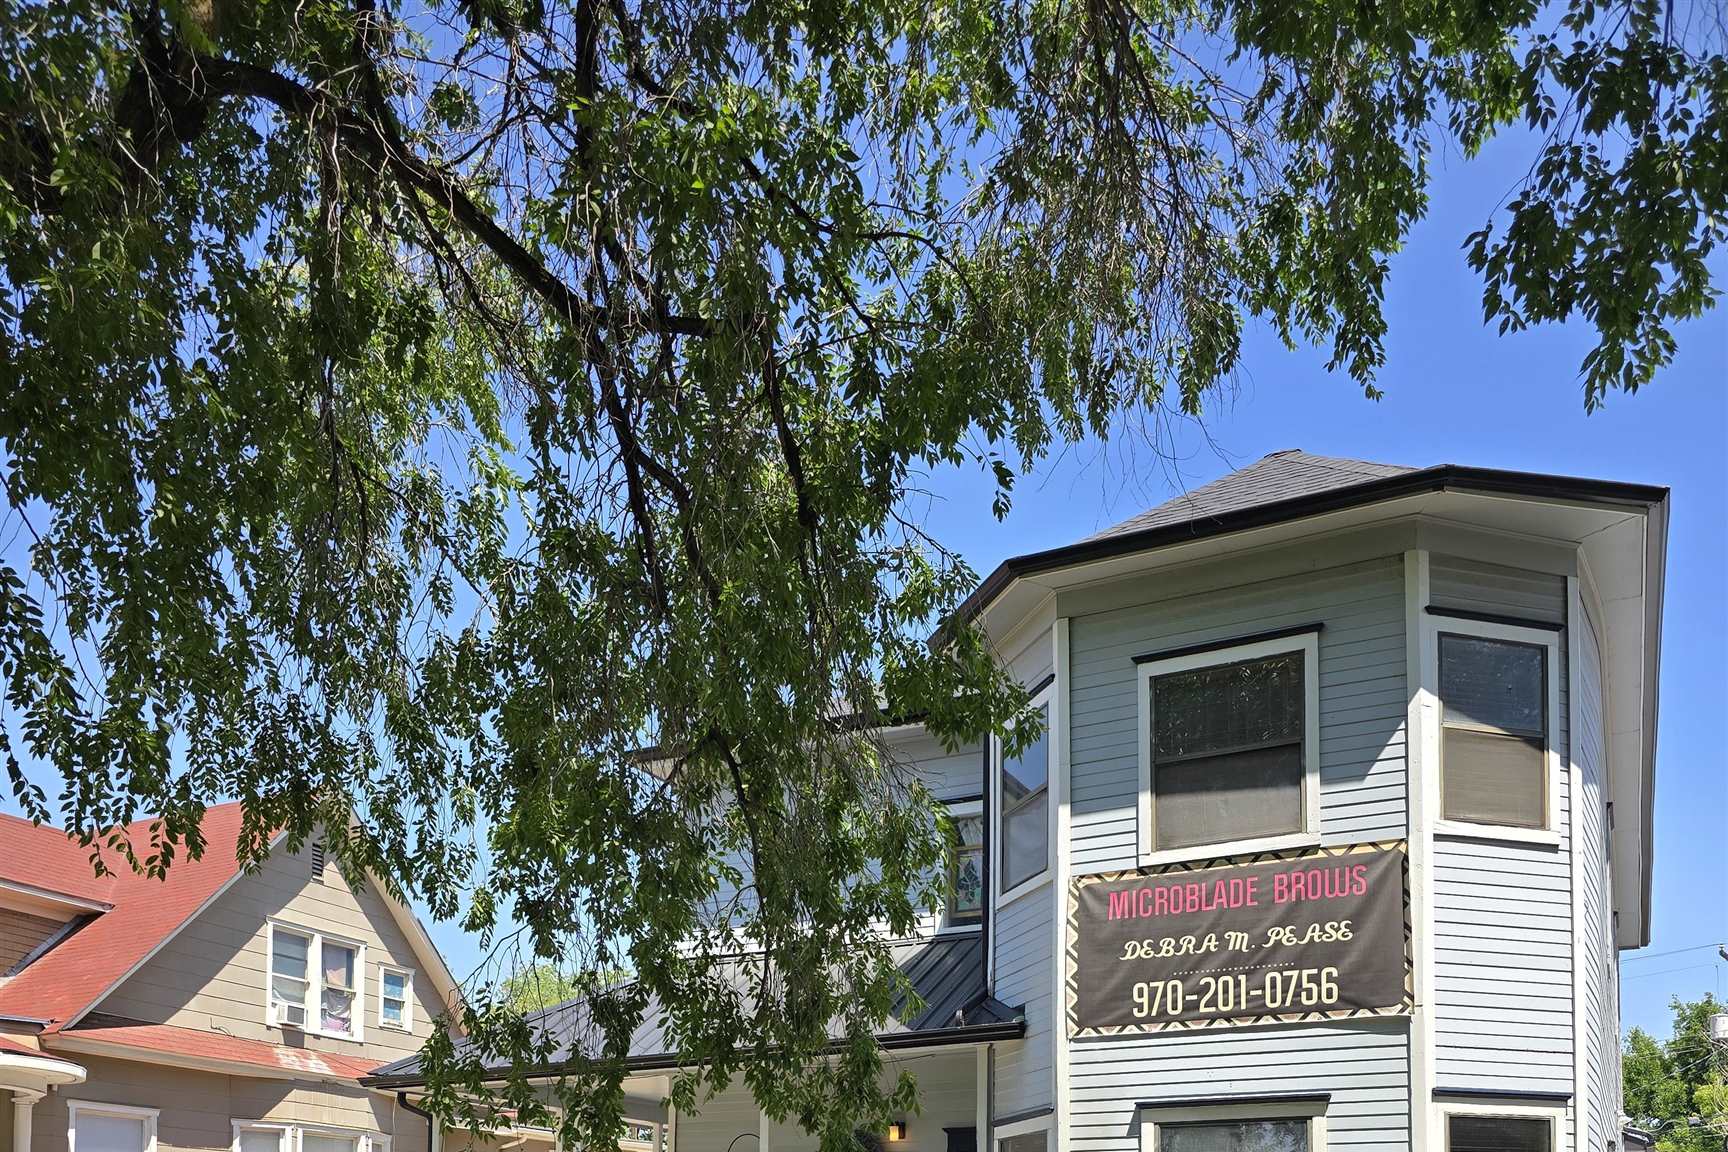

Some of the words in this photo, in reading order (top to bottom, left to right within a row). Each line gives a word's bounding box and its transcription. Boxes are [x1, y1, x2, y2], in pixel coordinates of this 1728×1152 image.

[1108, 876, 1259, 920] MICROBLADE
[1273, 864, 1369, 904] BROWS
[1119, 933, 1219, 960] DEBRA
[1224, 930, 1256, 953] M.
[1262, 920, 1353, 948] PEASE
[1132, 966, 1339, 1018] 970-201-0756
